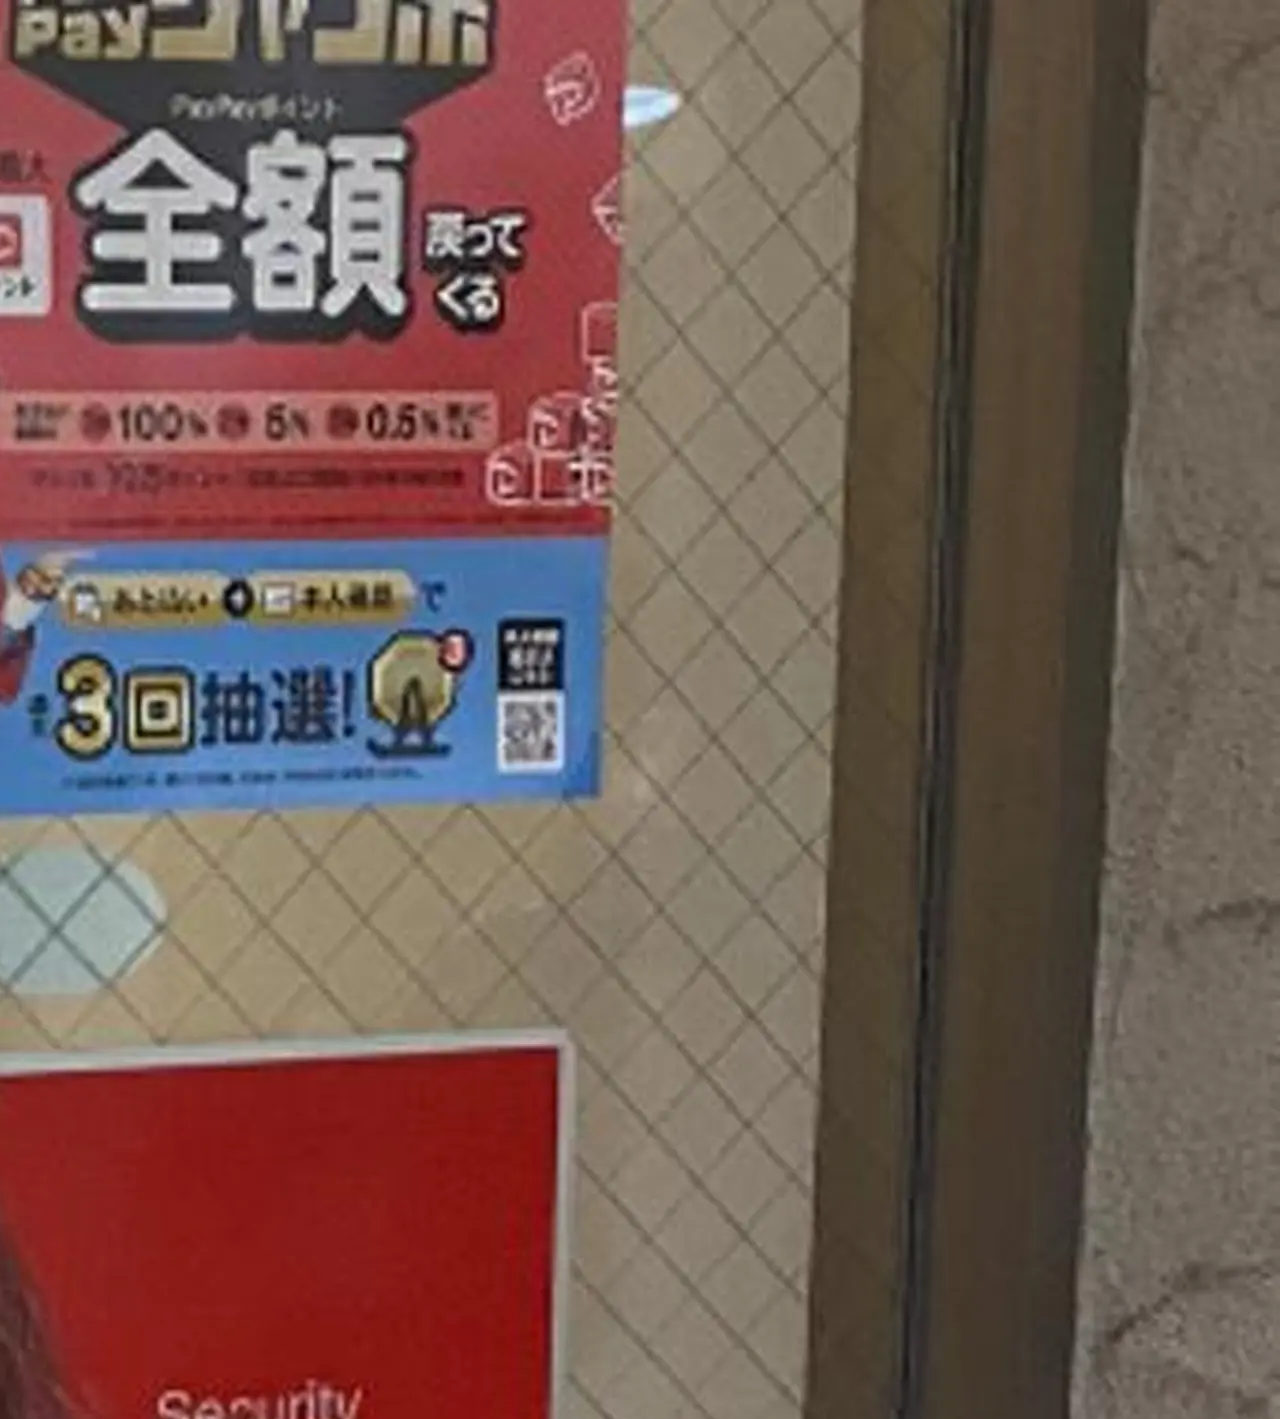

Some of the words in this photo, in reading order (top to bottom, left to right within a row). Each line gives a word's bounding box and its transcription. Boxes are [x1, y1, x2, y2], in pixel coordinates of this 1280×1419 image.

[75, 128, 409, 317] 全額
[424, 211, 527, 259] 戻って
[436, 275, 504, 322] くる
